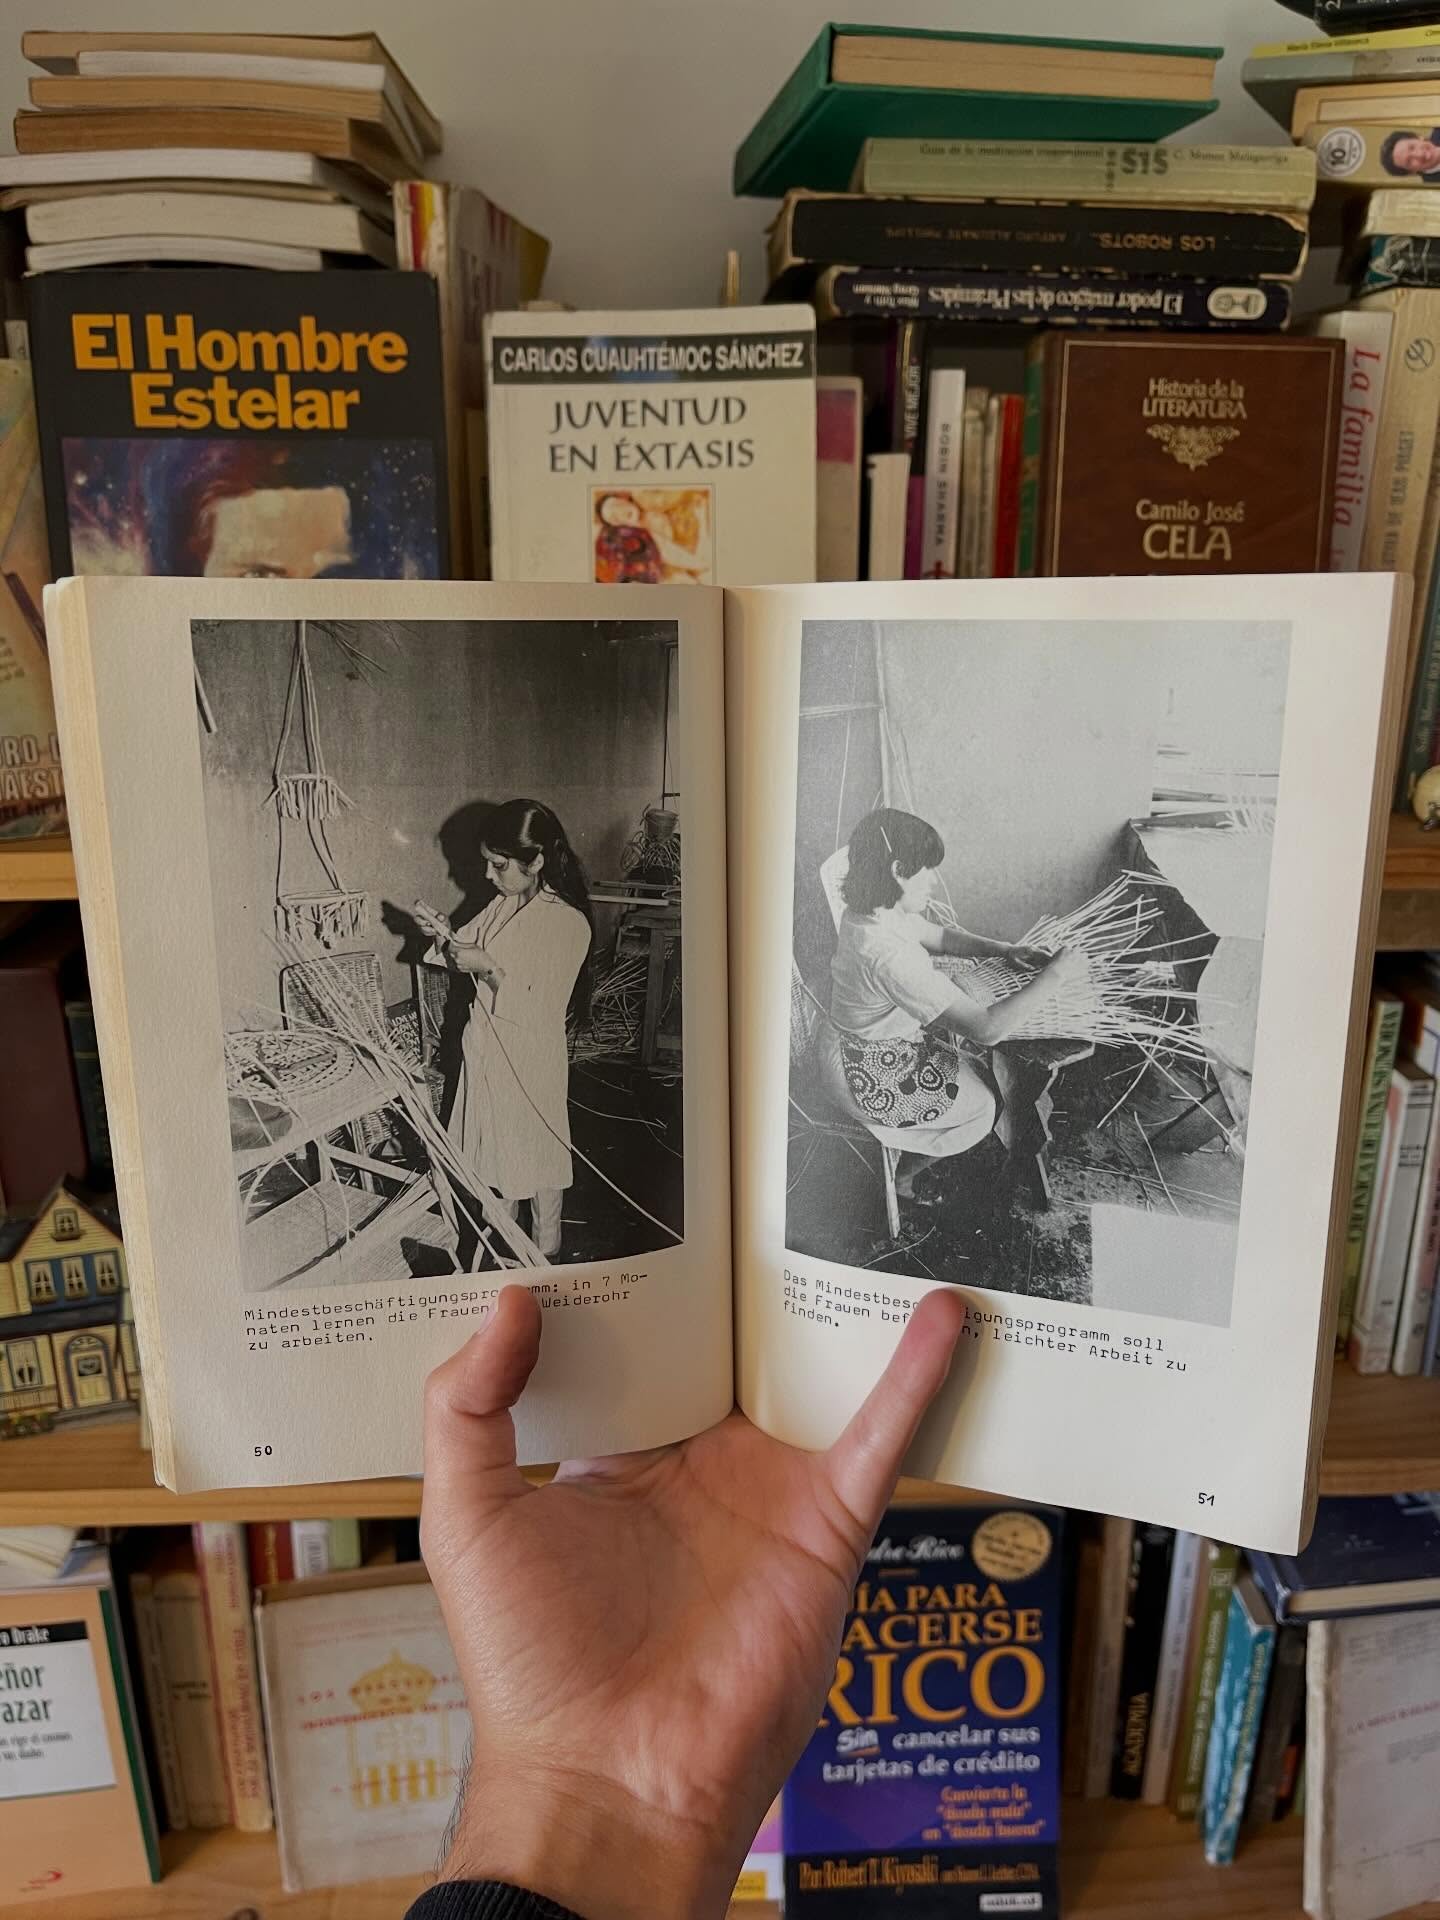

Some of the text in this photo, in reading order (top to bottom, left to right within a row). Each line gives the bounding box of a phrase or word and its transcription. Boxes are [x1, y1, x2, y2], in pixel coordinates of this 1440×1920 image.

[1180, 234, 1216, 251] LOS
[1034, 289, 1055, 312] de
[1116, 287, 1162, 313] poder
[1163, 292, 1183, 314] El
[71, 313, 409, 373] El Hombre
[500, 338, 804, 373] CARLOS CUAUHTÉMOC SÁNCHEZ
[1350, 345, 1381, 392] La
[131, 372, 361, 430] Estelar
[1149, 377, 1245, 399] Historia de la
[550, 396, 748, 434] JUVENTUD
[1142, 397, 1248, 419] LITERATURA
[549, 437, 755, 473] EN ÉXTASIS
[1333, 405, 1374, 528] familia
[933, 423, 951, 546] ROBIN SHARMA
[1135, 498, 1245, 525] Camilo José
[1143, 523, 1233, 561] CELA
[244, 1272, 649, 1321] Mindestbeschäftigungspromm: in 7 Mo-
[784, 1269, 1164, 1352] Das Mindestbescigungsprogramm soll
[246, 1289, 631, 1336] naten lernen die Frauen Weiderohr
[784, 1300, 839, 1328] finden.
[249, 1332, 374, 1351] zu arbeiten.
[784, 1286, 807, 1302] die
[815, 1294, 870, 1318] Frauen
[993, 1328, 1077, 1353] leichter
[1089, 1345, 1153, 1366] Arbeit
[1166, 1359, 1187, 1372] zu
[253, 1445, 273, 1458] 50
[1197, 1492, 1215, 1508] 51
[904, 1583, 1007, 1612] PARA
[11, 1626, 50, 1645] Drake
[842, 1609, 1044, 1650] ACERSE
[2, 1699, 52, 1723] azar
[836, 1724, 1041, 1751] Sin cancelar sus
[822, 1750, 1041, 1784] tarjetas de crédito
